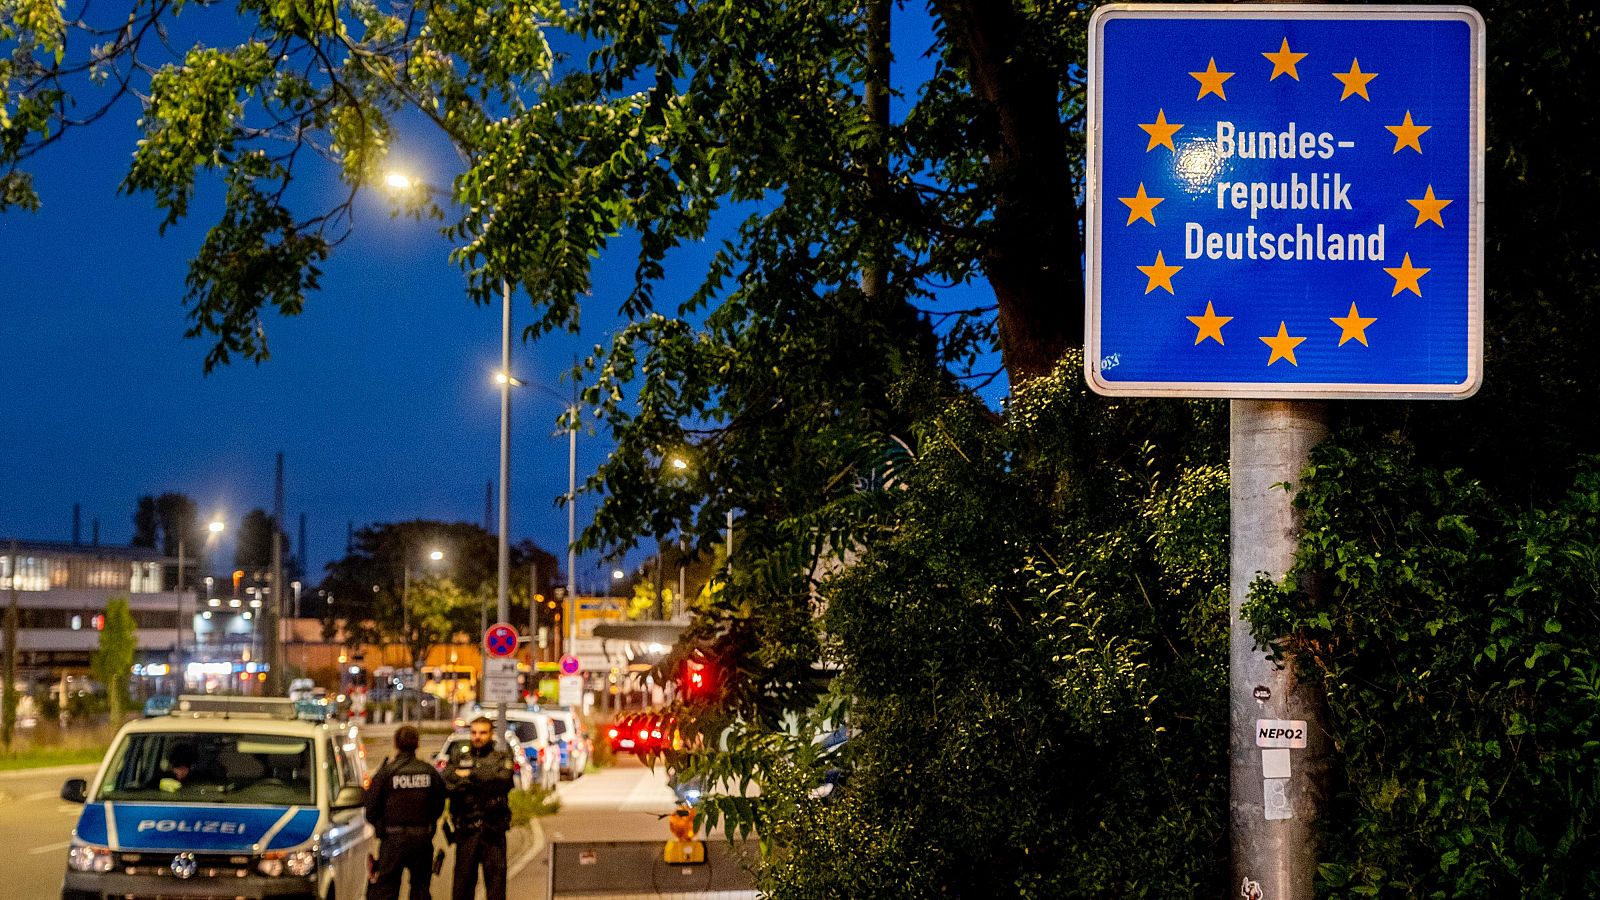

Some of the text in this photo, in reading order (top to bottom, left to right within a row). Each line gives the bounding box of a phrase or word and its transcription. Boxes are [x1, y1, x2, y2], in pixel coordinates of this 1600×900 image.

[1216, 121, 1355, 159] Bundes-
[1217, 173, 1352, 219] republik
[1185, 223, 1385, 261] Deutschland
[1259, 728, 1302, 740] NEPO2
[392, 775, 431, 789] POLIZEI
[137, 819, 246, 834] POLIZEI
